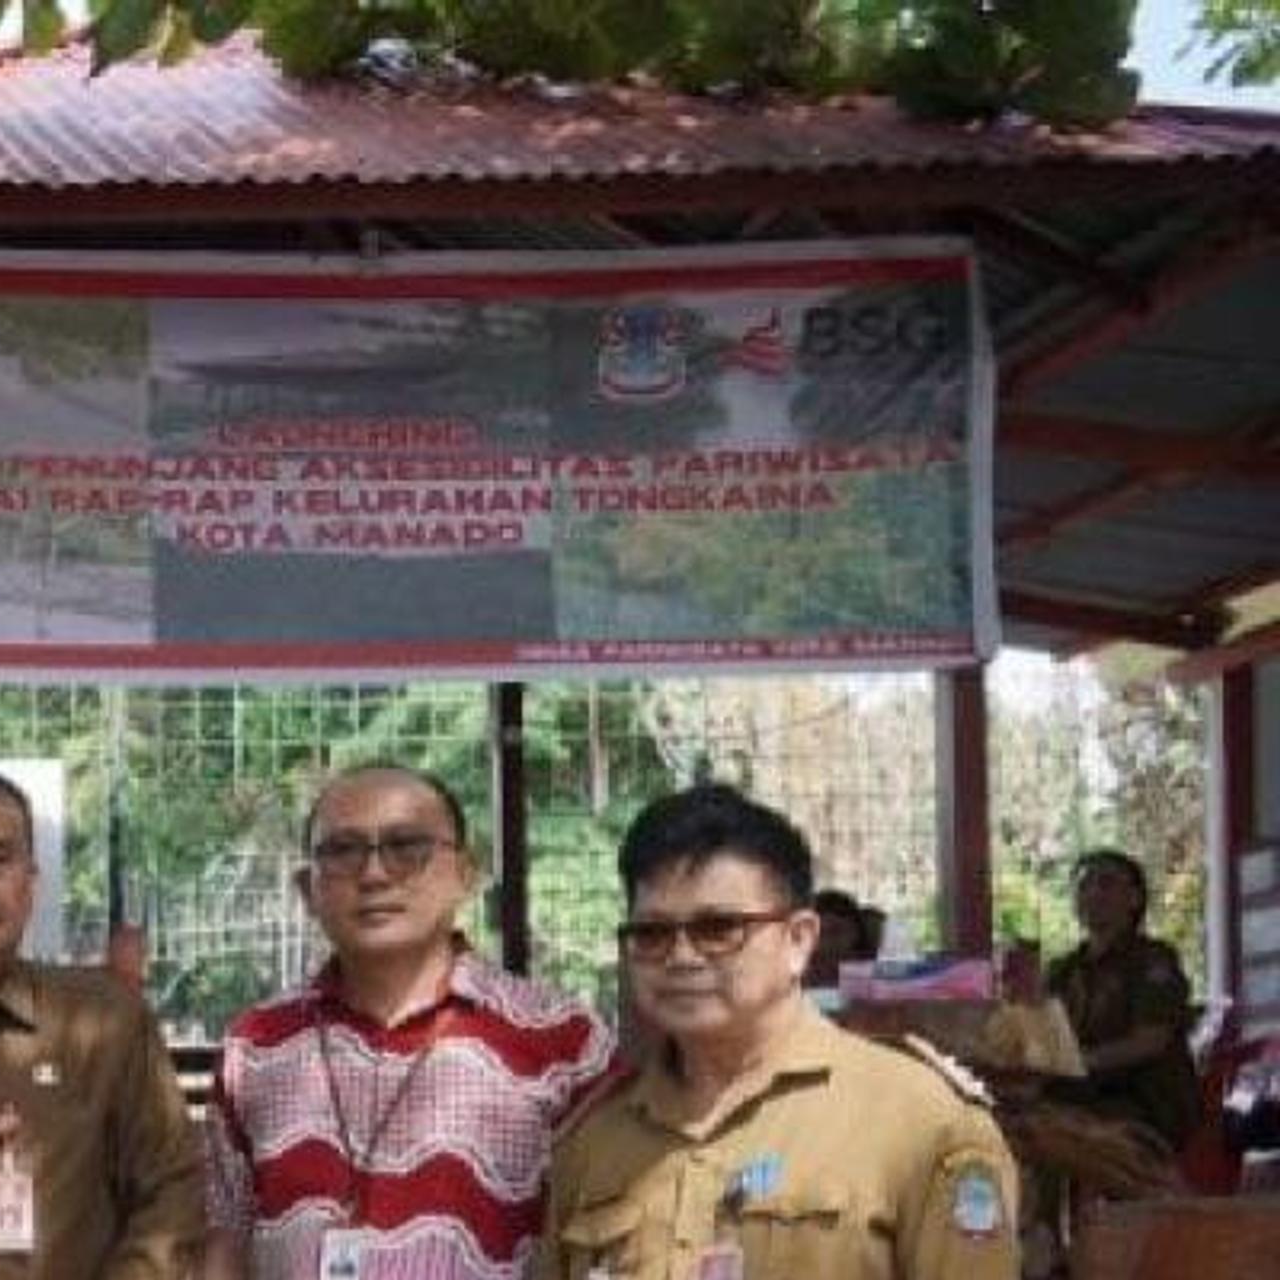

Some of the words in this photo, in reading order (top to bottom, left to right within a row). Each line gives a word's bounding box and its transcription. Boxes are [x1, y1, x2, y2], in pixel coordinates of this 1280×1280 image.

[804, 306, 951, 356] BSG
[654, 437, 961, 479] PARIWISATA
[49, 485, 256, 515] RAP-RAP
[272, 486, 553, 515] KELURAHAN
[572, 480, 836, 514] TONGKAINA
[174, 517, 294, 550] KOTA
[315, 518, 524, 549] MANADO
